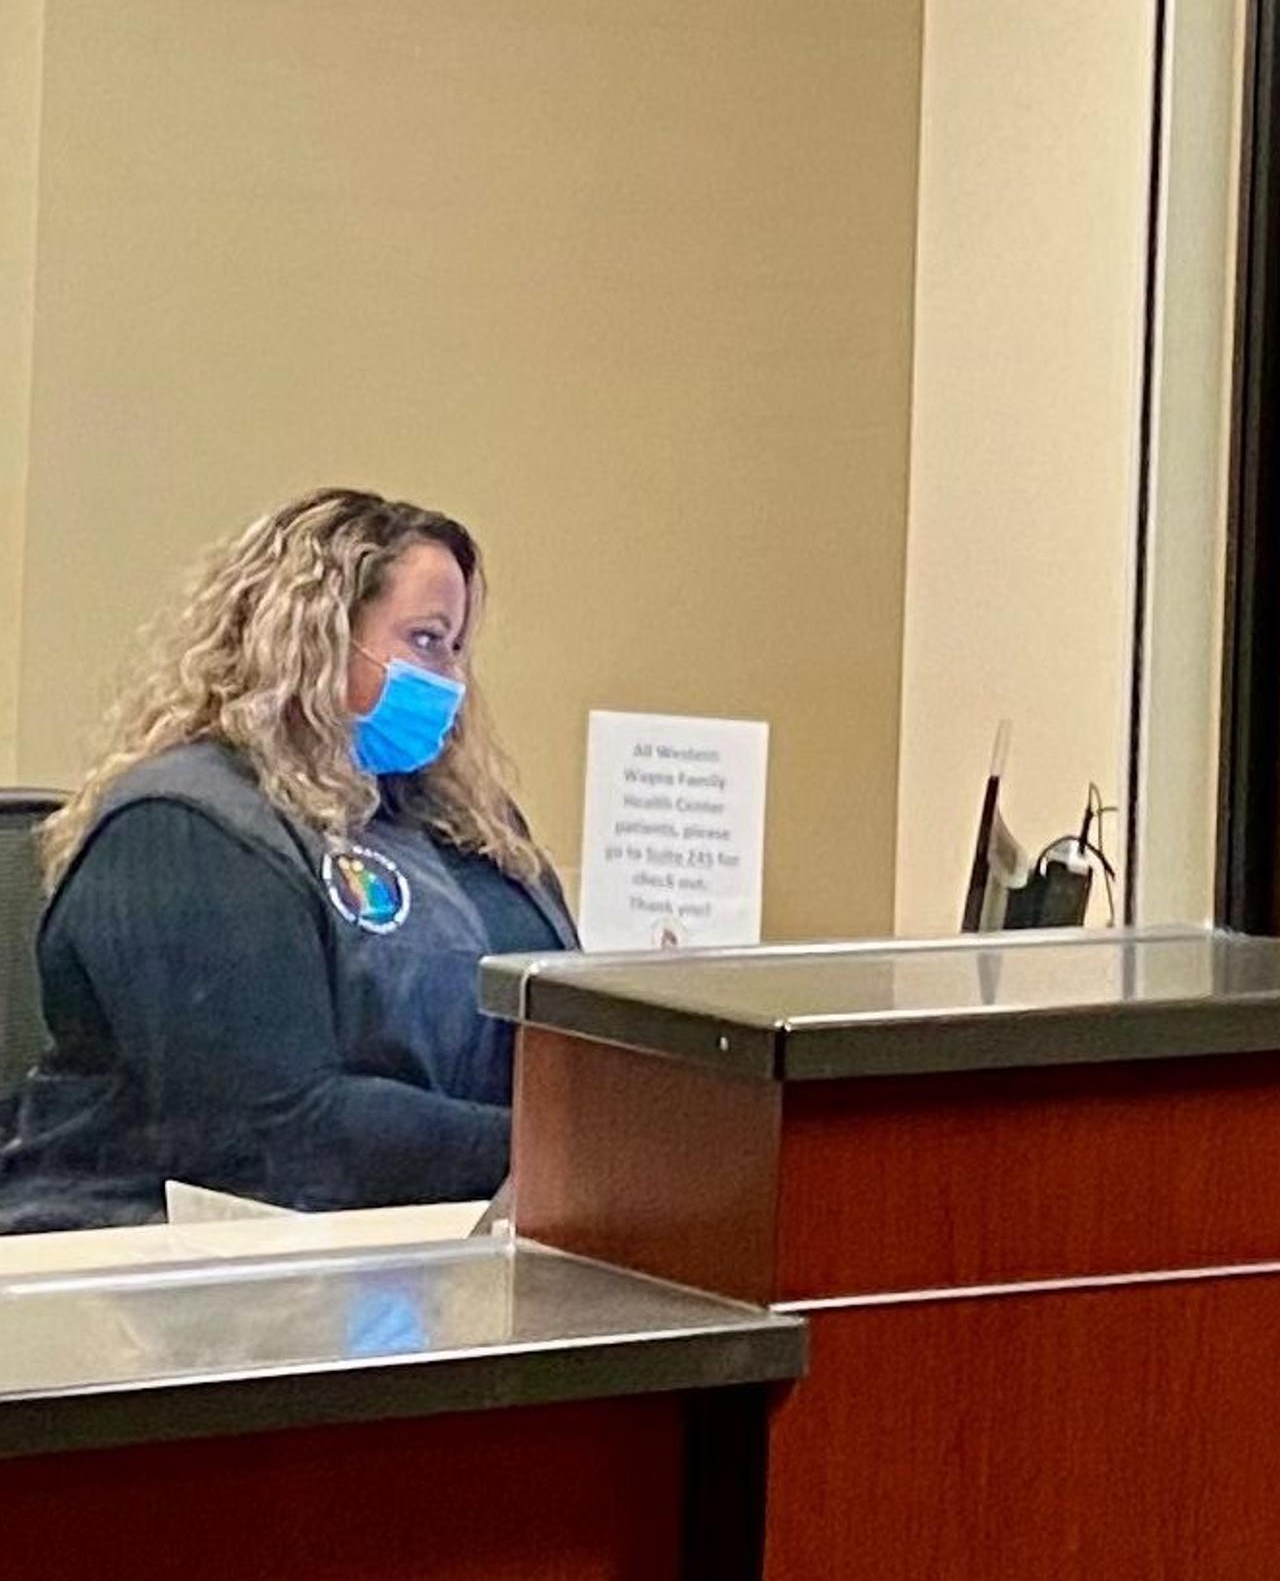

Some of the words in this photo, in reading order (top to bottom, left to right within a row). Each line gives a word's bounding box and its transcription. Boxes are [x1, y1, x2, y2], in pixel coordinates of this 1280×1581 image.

[634, 743, 652, 756] All
[678, 771, 725, 792] Family
[628, 895, 674, 914] Thank
